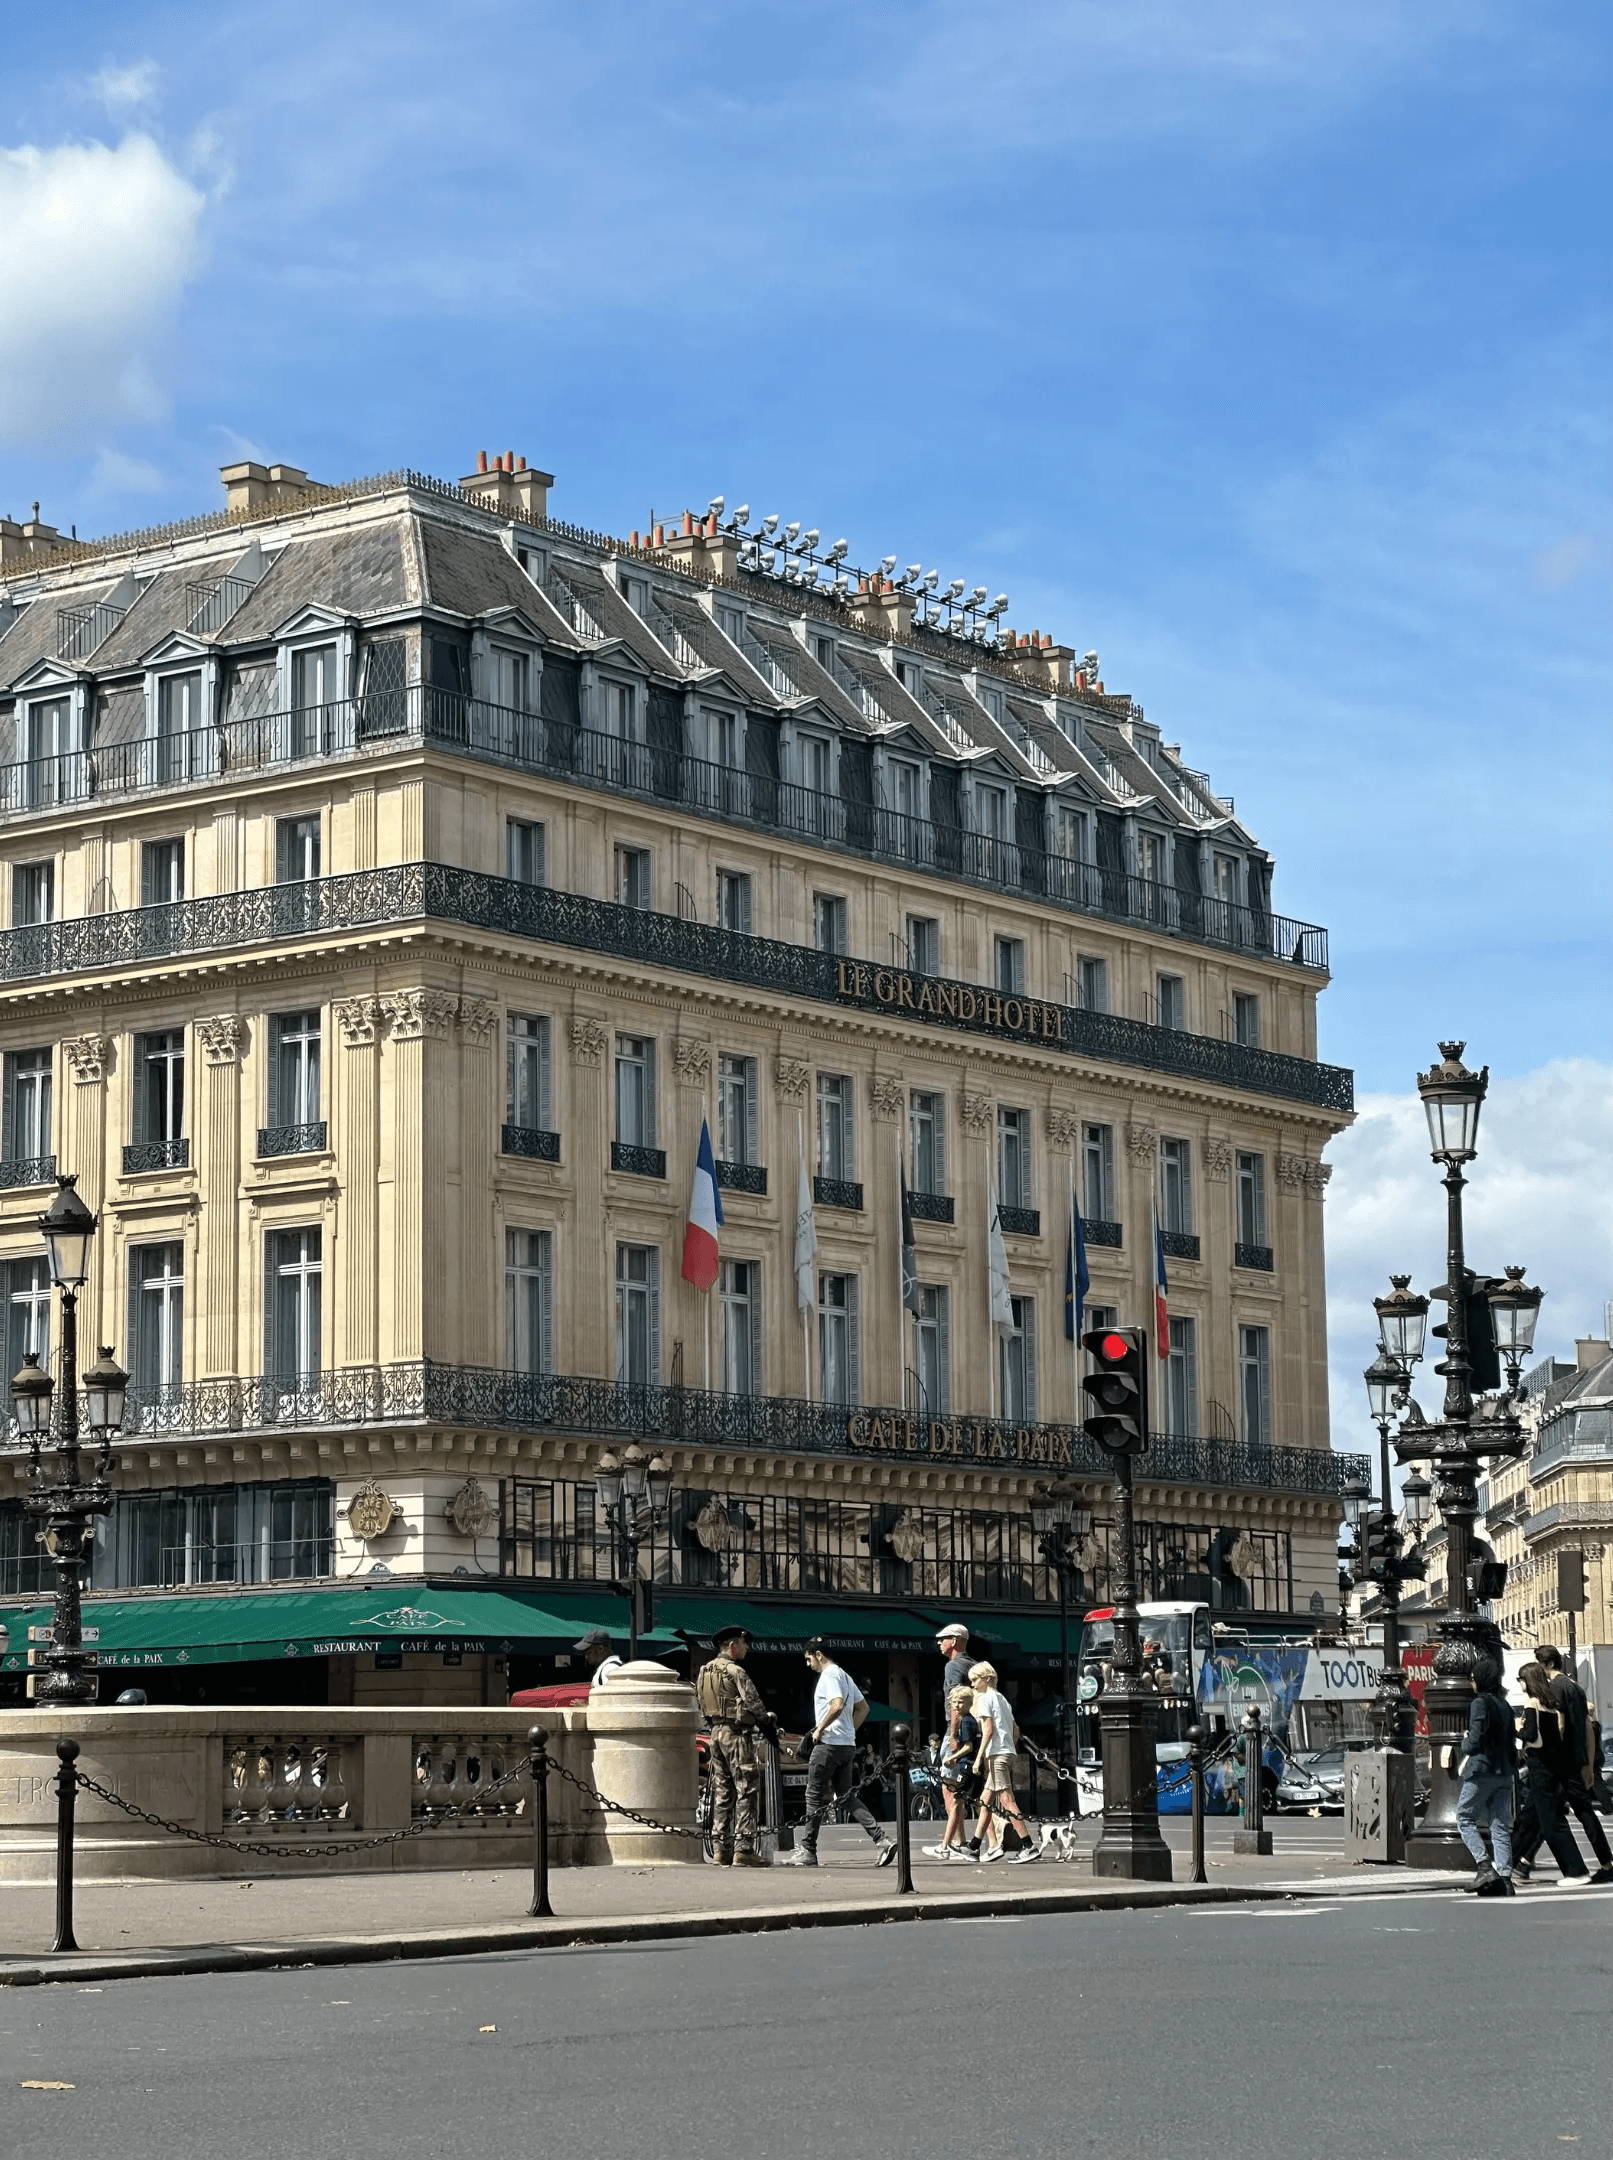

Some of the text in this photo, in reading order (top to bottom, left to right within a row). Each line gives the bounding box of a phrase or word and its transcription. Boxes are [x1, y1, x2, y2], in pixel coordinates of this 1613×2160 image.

[838, 962, 1069, 1041] LE GRAND HOTEL
[929, 1421, 964, 1455] DE
[974, 1425, 1007, 1458] LA
[1016, 1429, 1073, 1463] PAIX
[313, 1639, 486, 1653] RESTAURANT CAFÉ de la PAIX
[829, 1639, 865, 1649] ESTAURANT
[908, 1640, 923, 1650] PAIX
[98, 1653, 163, 1665] CAFÉ de la PAIX
[1320, 1660, 1382, 1688] TOOTBU
